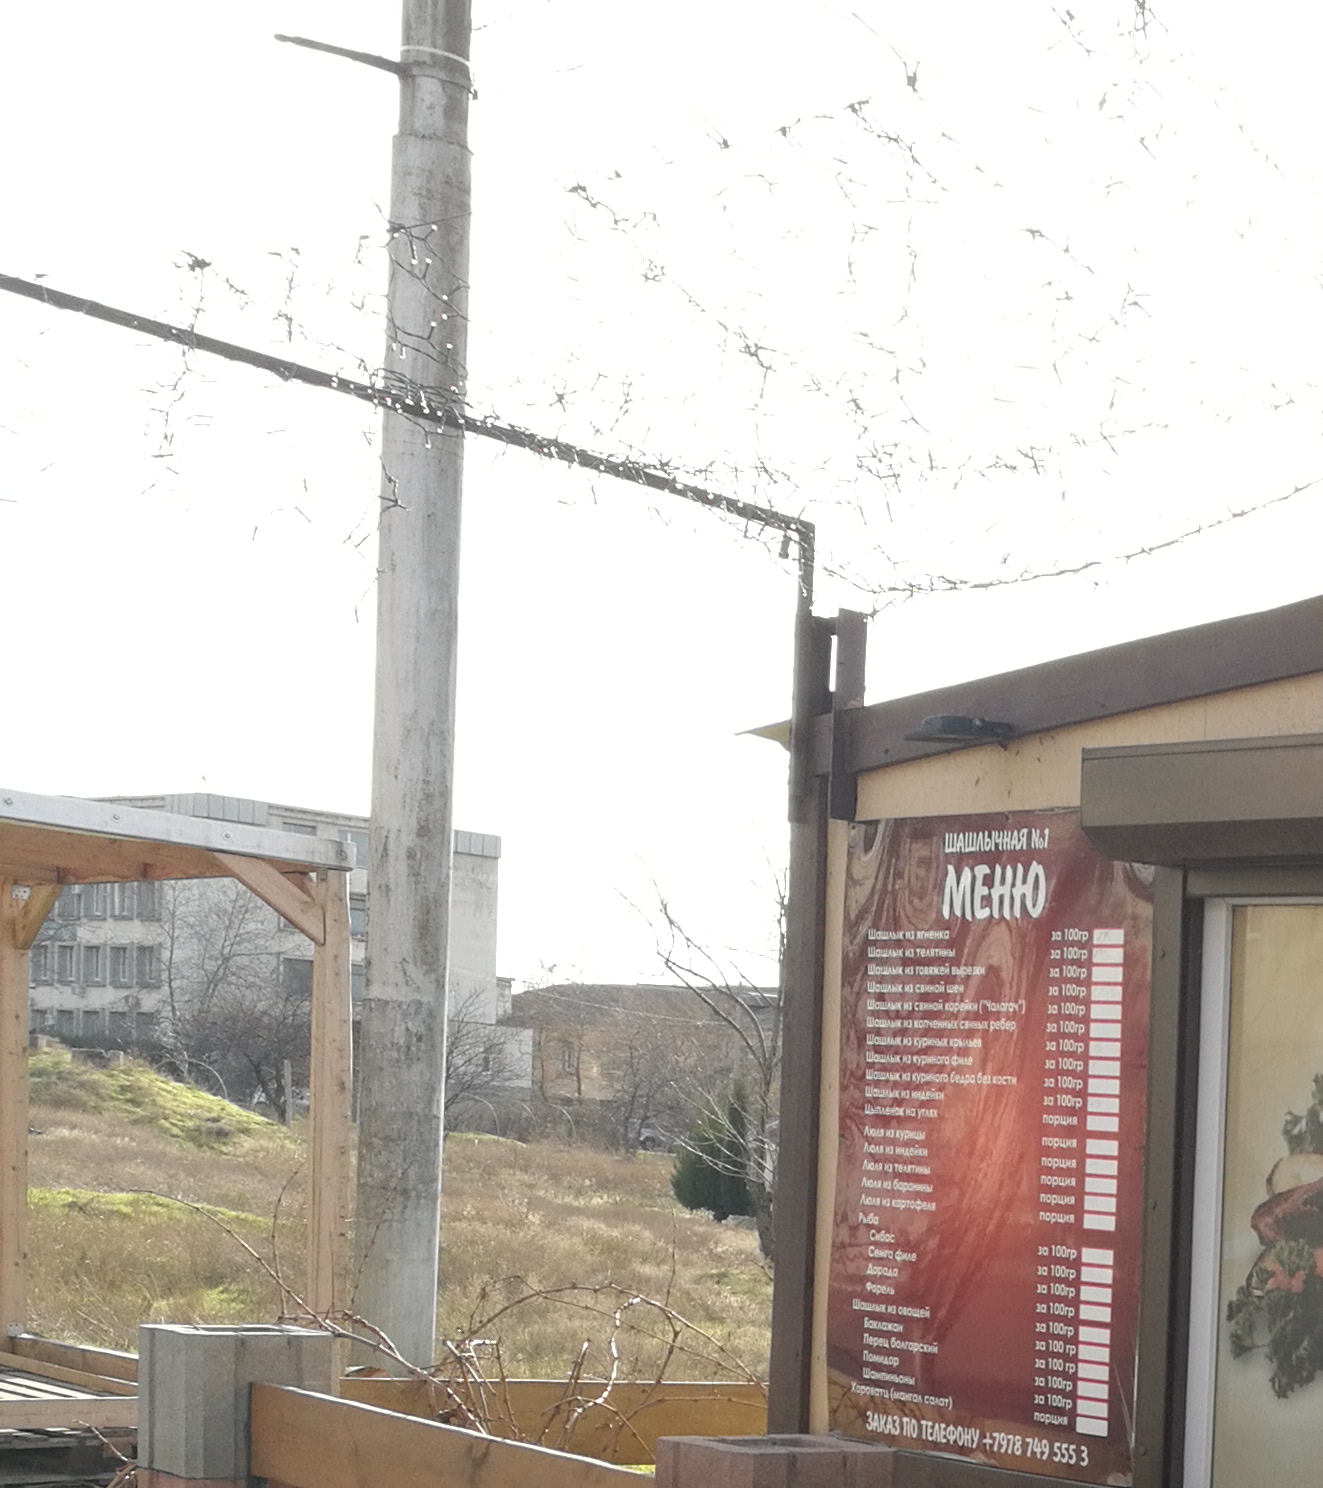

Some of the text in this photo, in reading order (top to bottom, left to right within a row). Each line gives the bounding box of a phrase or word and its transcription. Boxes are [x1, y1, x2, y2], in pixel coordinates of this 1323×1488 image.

[944, 828, 1028, 853] ШАШЛЫЧНАЯ
[942, 860, 1047, 922] МЕНЮ
[868, 929, 950, 941] Шашлык из ягненка
[1051, 928, 1088, 942] за 100гр
[868, 946, 956, 958] Шашлык из телятины
[1050, 947, 1088, 961] за 100гр
[868, 963, 985, 977] Шашлык из говяжей вырезки
[1049, 966, 1087, 980] за 100гр
[867, 982, 964, 993] Шашлык из свиной шеи
[1048, 984, 1086, 998] за 100гр
[867, 999, 902, 1010] Шашлык
[904, 1002, 912, 1010] из
[914, 1000, 943, 1011] свиной
[945, 1000, 978, 1013] корейки
[1048, 1002, 1086, 1017] за 100гр
[866, 1017, 902, 1028] Шашлык
[903, 1020, 912, 1028] из
[960, 1020, 988, 1030] свиных
[990, 1019, 1016, 1032] ребер
[1046, 1021, 1084, 1036] за 100гр
[866, 1034, 982, 1049] Шашлык из куриных крыльев
[1046, 1040, 1084, 1054] за 100гр
[866, 1052, 972, 1066] Шашлык из куриного филе
[1044, 1058, 1084, 1072] за 100гр
[866, 1069, 1017, 1086] Шашлык из куриного бедра без кости
[1044, 1076, 1083, 1090] за 100гр
[865, 1086, 944, 1100] Шашлык из индейки
[1043, 1094, 1082, 1109] за 100гр
[906, 1108, 916, 1116] на
[918, 1108, 938, 1119] углях
[1042, 1114, 1078, 1127] порция
[864, 1126, 926, 1141] Люля из курицы
[863, 1142, 928, 1157] Люля из индейки
[1042, 1137, 1077, 1150] порция
[862, 1160, 931, 1175] Люля из телятины
[1041, 1157, 1076, 1169] порция
[861, 1176, 933, 1192] Люля из баранины
[1040, 1175, 1076, 1188] порция
[860, 1194, 936, 1212] Люля из картофеля
[1040, 1194, 1076, 1206] порция
[858, 1212, 880, 1225] Рыба
[1039, 1212, 1075, 1224] порция
[894, 1249, 917, 1262] филе
[1038, 1245, 1077, 1260] за 100гр
[1037, 1264, 1076, 1280] за 100гр
[1036, 1283, 1076, 1298] за 100гр
[852, 1298, 930, 1319] Шашлык из овощей
[1036, 1302, 1075, 1318] за 100гр
[864, 1317, 903, 1332] Баклажан
[1036, 1322, 1074, 1337] за 100гр
[863, 1333, 938, 1354] Перец болгарский
[1035, 1340, 1076, 1356] за 100 гр
[863, 1350, 900, 1367] Помидор
[1035, 1358, 1076, 1374] за 100 гр
[863, 1368, 916, 1386] Шампиньоны
[1034, 1376, 1072, 1392] за 100гр
[890, 1388, 922, 1404] (мангал
[924, 1396, 954, 1410] салат)
[1034, 1394, 1072, 1410] за 100гр
[1034, 1411, 1068, 1426] порция
[866, 1411, 1089, 1467] ЗАКАЗ ПО ТЕЛЕФОНУ +7978 749 555 3
